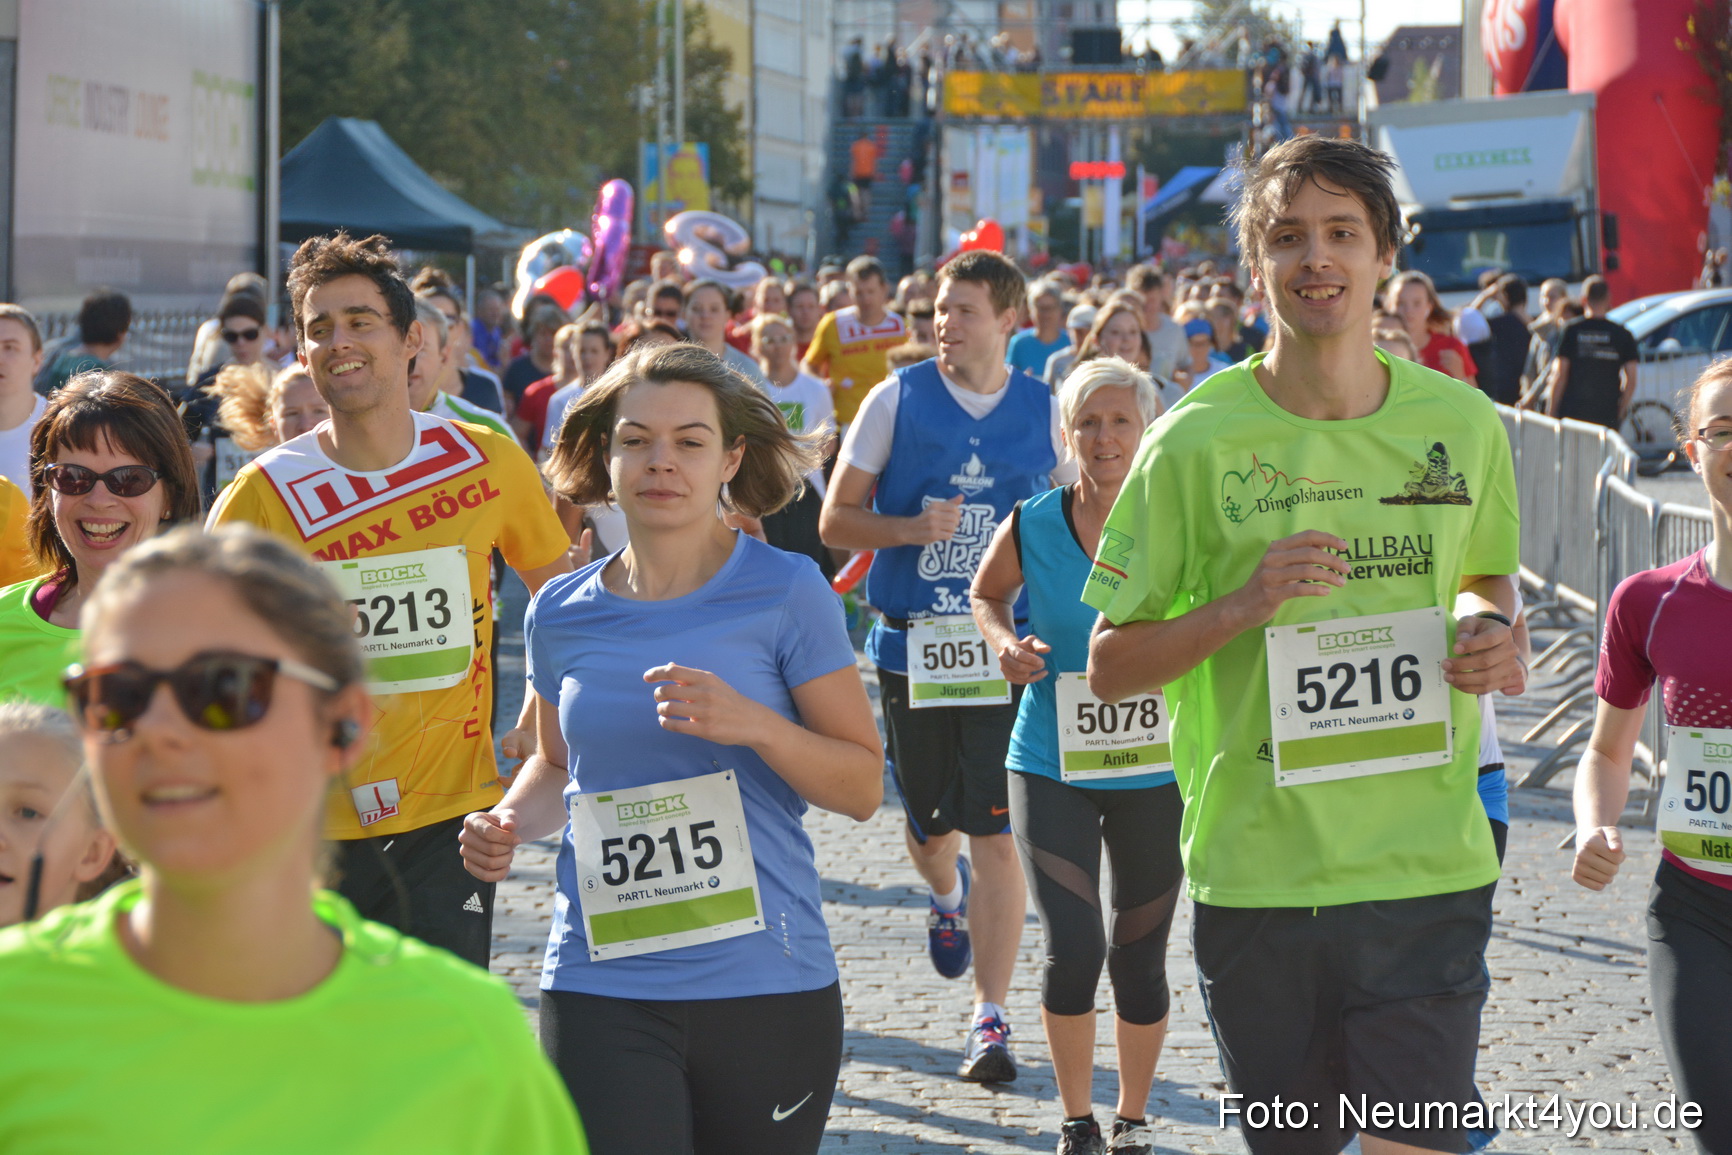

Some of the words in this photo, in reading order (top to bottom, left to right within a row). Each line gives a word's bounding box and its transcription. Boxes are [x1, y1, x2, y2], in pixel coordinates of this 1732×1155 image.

[1256, 487, 1363, 513] Dingolshausen
[310, 517, 402, 562] MAX
[407, 478, 501, 531] BÖGL
[360, 563, 426, 585] BOCK
[345, 587, 451, 638] 5213
[935, 623, 977, 635] BOCK
[1318, 626, 1394, 650] BOCK
[390, 638, 433, 650] Neumarkt
[923, 640, 988, 670] 5051
[940, 686, 980, 698] Jürgen
[1297, 654, 1422, 714] 5216
[1077, 698, 1159, 734] 5078
[1281, 707, 1287, 716] S
[1310, 718, 1346, 730] PARTL
[1348, 712, 1399, 726] Neumarkt
[1111, 736, 1144, 745] Neumarkt
[1703, 742, 1732, 758] BO
[1103, 752, 1138, 766] Anita
[1684, 769, 1731, 814] 50
[616, 793, 689, 821] BOCK
[1689, 818, 1718, 829] PARTL
[601, 820, 723, 886] 5215
[587, 879, 593, 889] S
[617, 887, 652, 903] PARTL
[654, 880, 704, 898] Neumarkt
[463, 903, 483, 913] adidas
